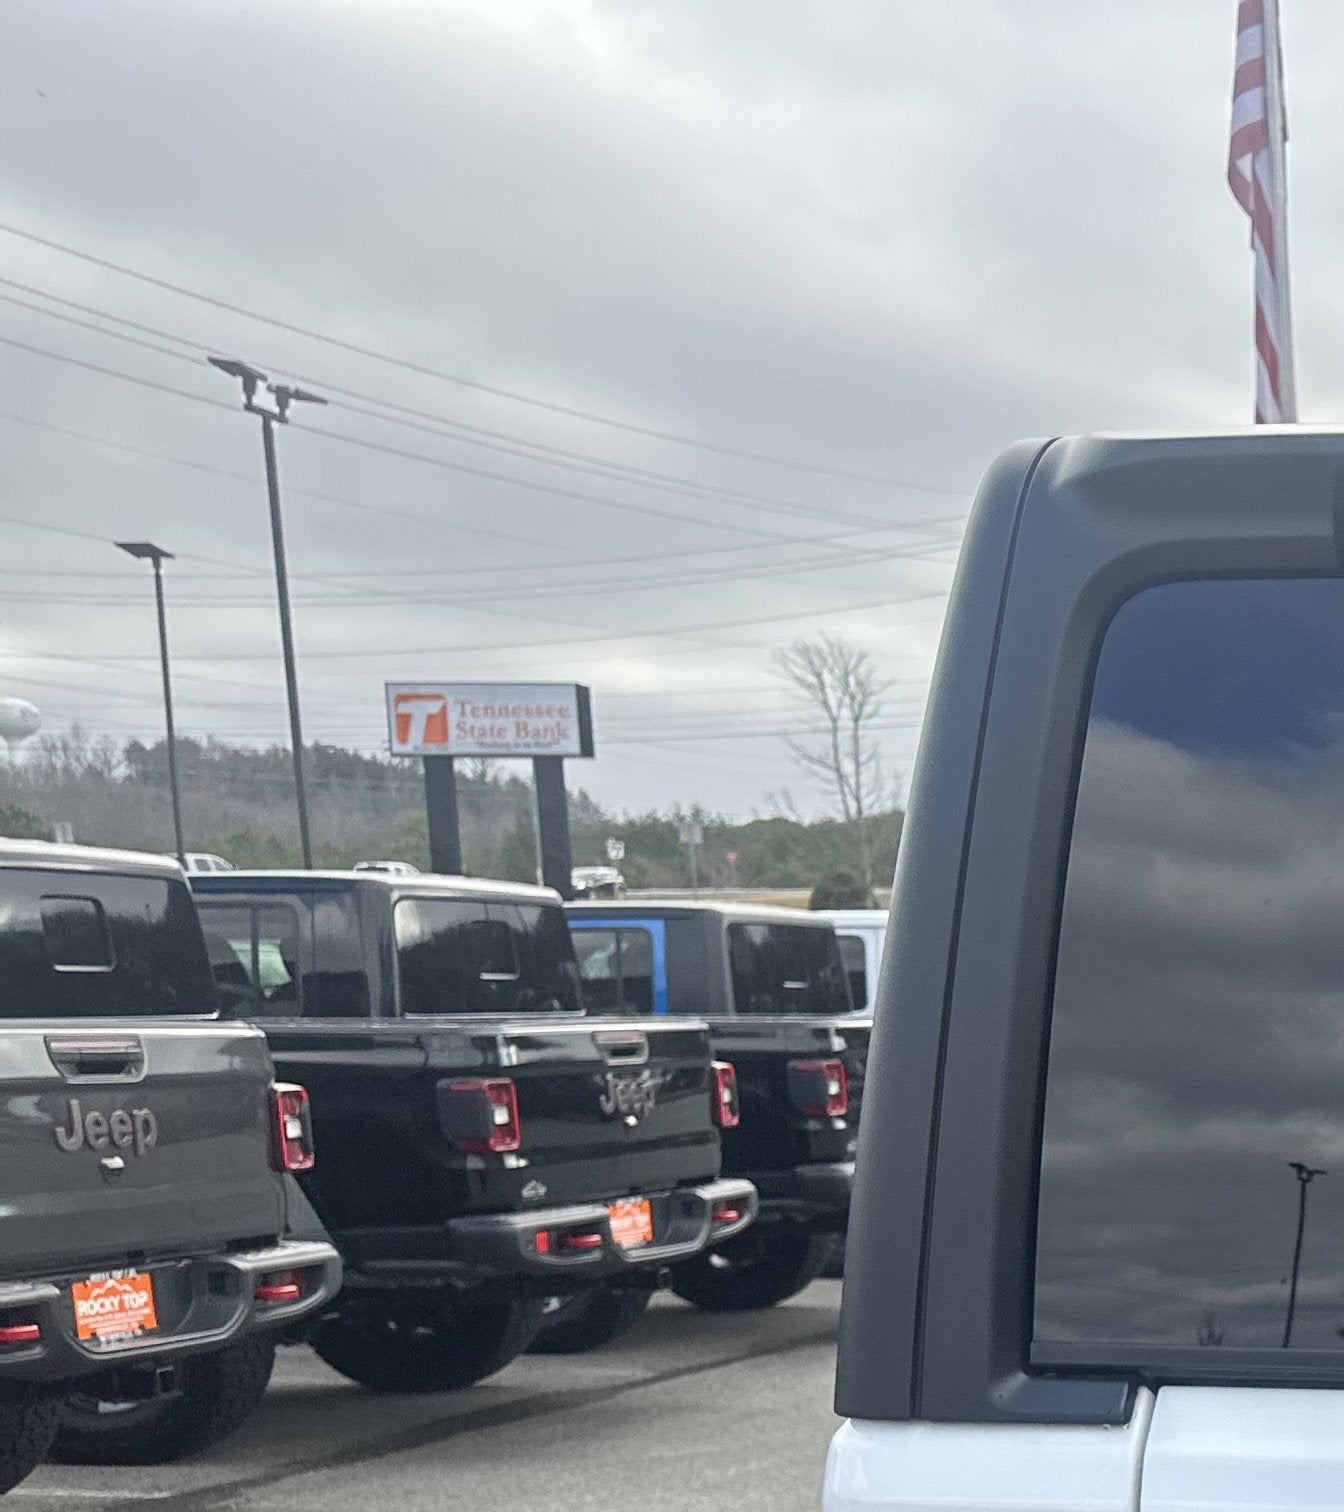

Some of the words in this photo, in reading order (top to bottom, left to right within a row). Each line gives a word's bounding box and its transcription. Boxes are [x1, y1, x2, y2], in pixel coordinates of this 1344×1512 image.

[454, 700, 570, 718] Tennessee
[455, 720, 508, 740] State
[515, 719, 570, 740] Bank
[55, 1098, 158, 1157] Jeep
[122, 1290, 149, 1311] TOP
